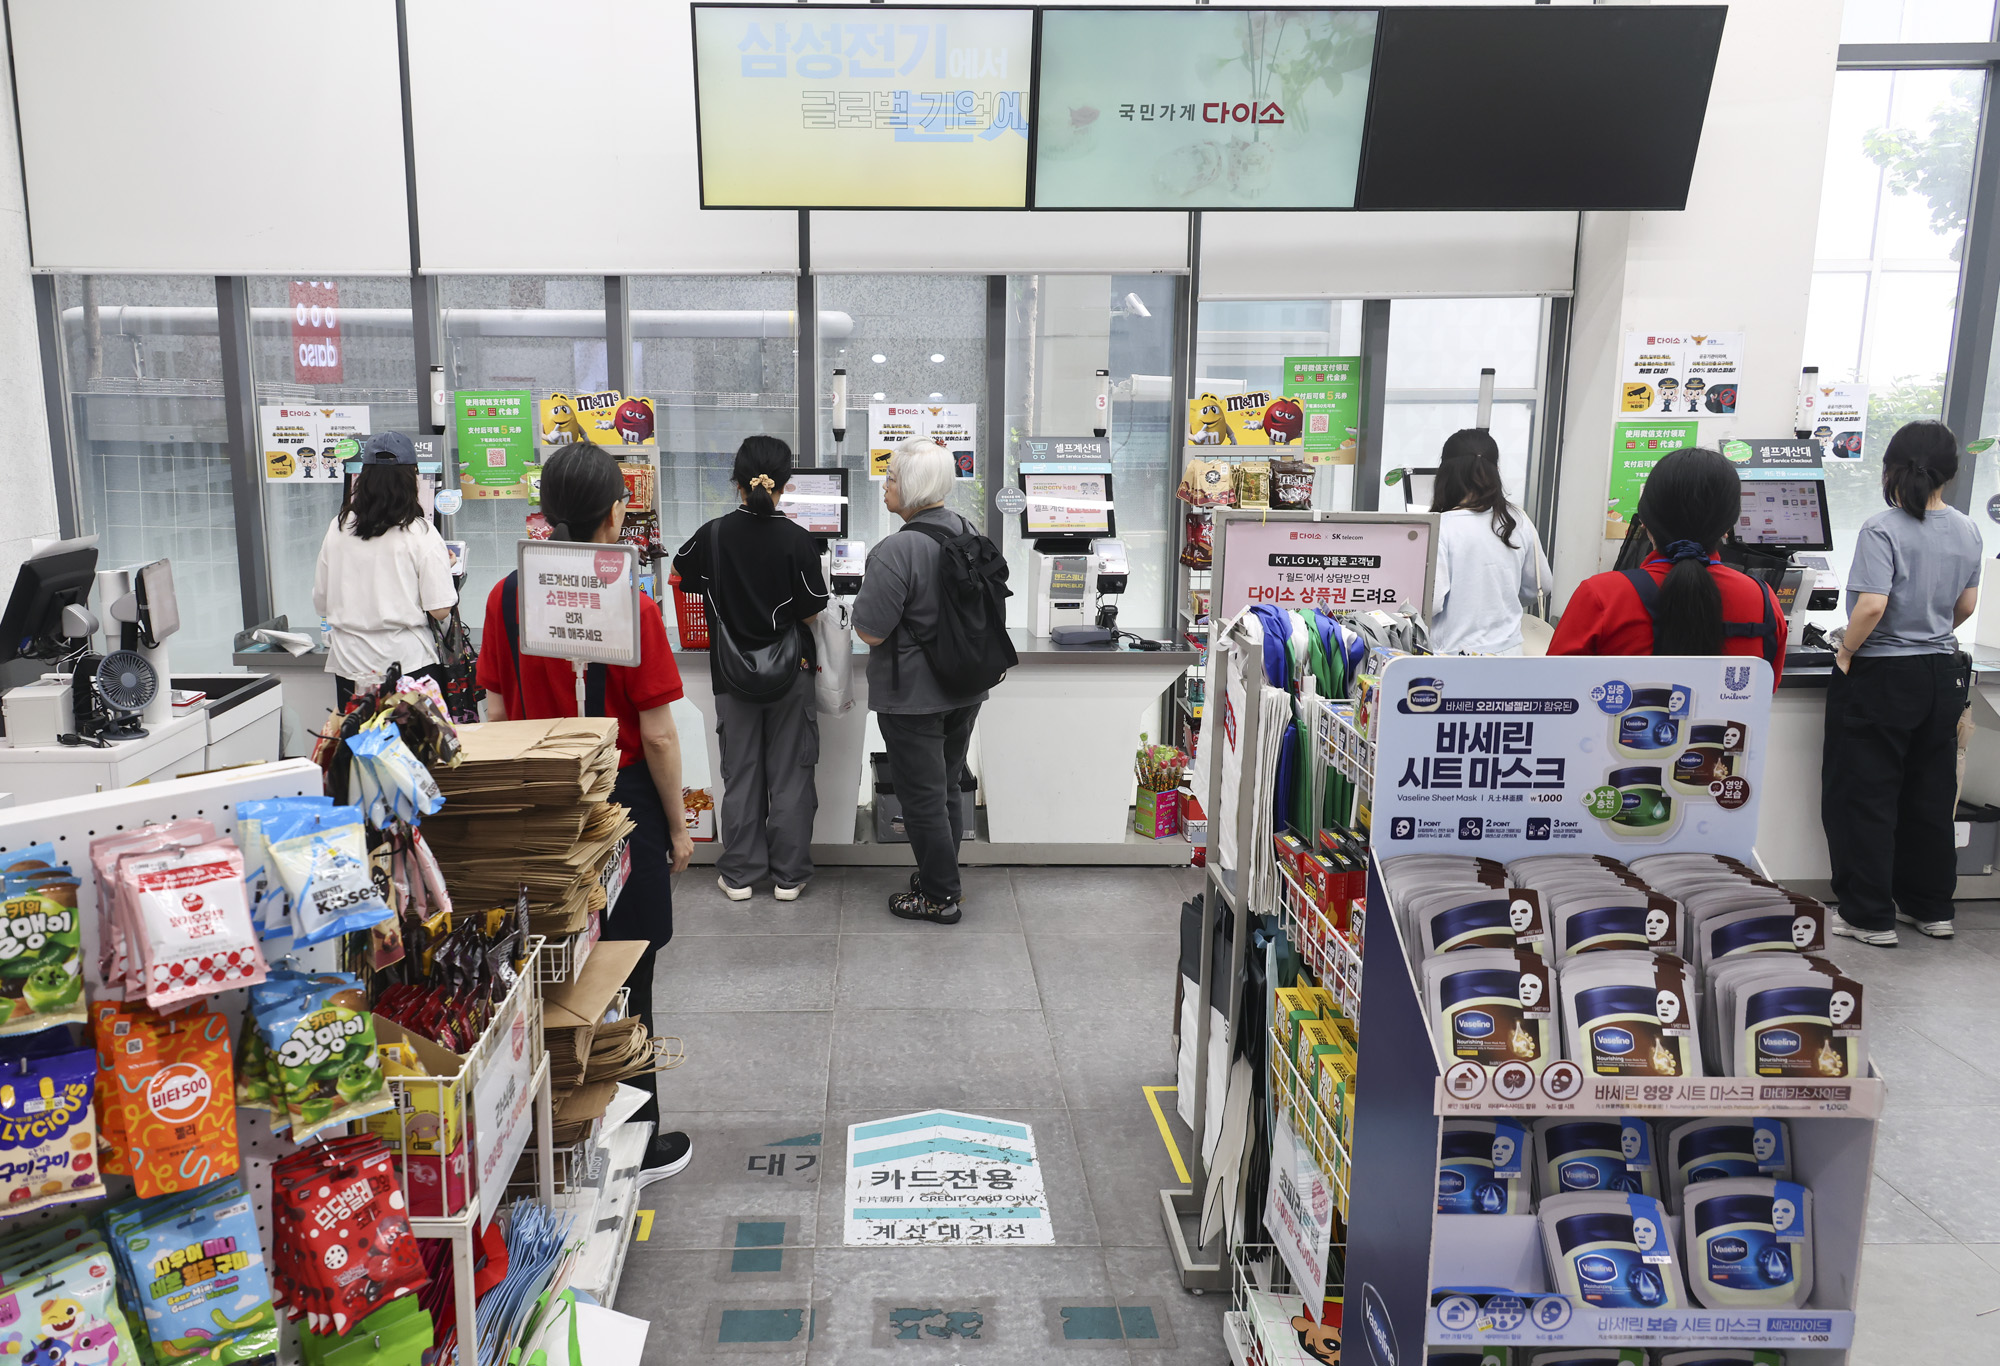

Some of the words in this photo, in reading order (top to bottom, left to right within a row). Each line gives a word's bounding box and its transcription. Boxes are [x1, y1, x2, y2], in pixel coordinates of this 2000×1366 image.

[1119, 103, 1196, 121] 국민가게
[1202, 101, 1285, 124] 다이소
[1294, 364, 1350, 372] 使用微信支付领取
[1327, 391, 1334, 400] 5
[1098, 397, 1105, 407] 3
[1806, 397, 1813, 407] 5
[501, 425, 508, 434] 5
[1625, 430, 1686, 438] 使用微信支付领取
[1054, 443, 1101, 453] 셀프계산대
[1760, 446, 1811, 457] 셀프계산대
[1275, 556, 1290, 565] KT,
[1291, 557, 1305, 565] LG
[1307, 557, 1321, 566] U+,
[1322, 557, 1348, 566] 알뜰폰
[1349, 557, 1374, 567] 고객님
[600, 565, 617, 573] daiso
[538, 573, 579, 587] 셀프계산대
[581, 574, 608, 589] 이용시
[1278, 573, 1284, 582] T
[1326, 573, 1370, 583] 상담받으면
[546, 590, 601, 609] 쇼핑봉투를
[1248, 586, 1295, 602] 다이소
[1299, 586, 1347, 604] 상품권
[1350, 588, 1397, 604] 드려요
[565, 612, 583, 624] 먼저
[548, 626, 566, 638] 구매
[567, 628, 603, 642] 해주세요
[1607, 685, 1625, 694] 집중
[1605, 695, 1624, 704] 보습
[1445, 701, 1474, 711] 바세린
[1475, 701, 1542, 711] 오리지널젤리가
[1543, 701, 1572, 711] 함유된
[1436, 721, 1533, 755] 바세린
[1397, 757, 1463, 790] 시트
[1469, 757, 1566, 790] 마스크
[1725, 780, 1743, 789] 영양
[1397, 794, 1430, 802] Vaseline
[1432, 794, 1454, 802] Sheet
[1456, 794, 1477, 802] Mask
[1597, 789, 1615, 799] 수분
[1724, 789, 1742, 799] 보습
[1596, 799, 1615, 809] 충전
[5, 901, 41, 919] 키위
[309, 1011, 337, 1030] 키위
[1458, 1019, 1491, 1028] Vaseline
[277, 1015, 365, 1068] 알맹이
[1597, 1035, 1631, 1045] Vaseline
[1762, 1037, 1798, 1047] Vaseline
[152, 1077, 208, 1109] 비타500
[1595, 1085, 1638, 1100] 바세린
[1643, 1085, 1673, 1100] 영양
[1677, 1085, 1706, 1100] 시트
[1710, 1086, 1755, 1100] 마스크
[1762, 1087, 1847, 1100] 마데카소사이드
[175, 1123, 197, 1140] 젤리
[871, 1168, 1018, 1190] 카드전용
[1565, 1171, 1596, 1180] Vaseline
[314, 1178, 374, 1231] 무당벌레
[872, 1224, 1026, 1239] 계산대기선
[1714, 1245, 1745, 1253] Vaseline
[215, 1251, 249, 1274] 구미
[1581, 1264, 1613, 1274] Vaseline
[167, 1291, 192, 1305] Sour
[192, 1283, 214, 1296] Mini
[1597, 1317, 1643, 1332] 바세린
[1646, 1317, 1678, 1332] 보습
[1681, 1317, 1712, 1332] 시트
[1715, 1318, 1760, 1332] 마스크
[1769, 1318, 1829, 1332] 세라마이드
[1365, 1297, 1395, 1366] Vaseline
